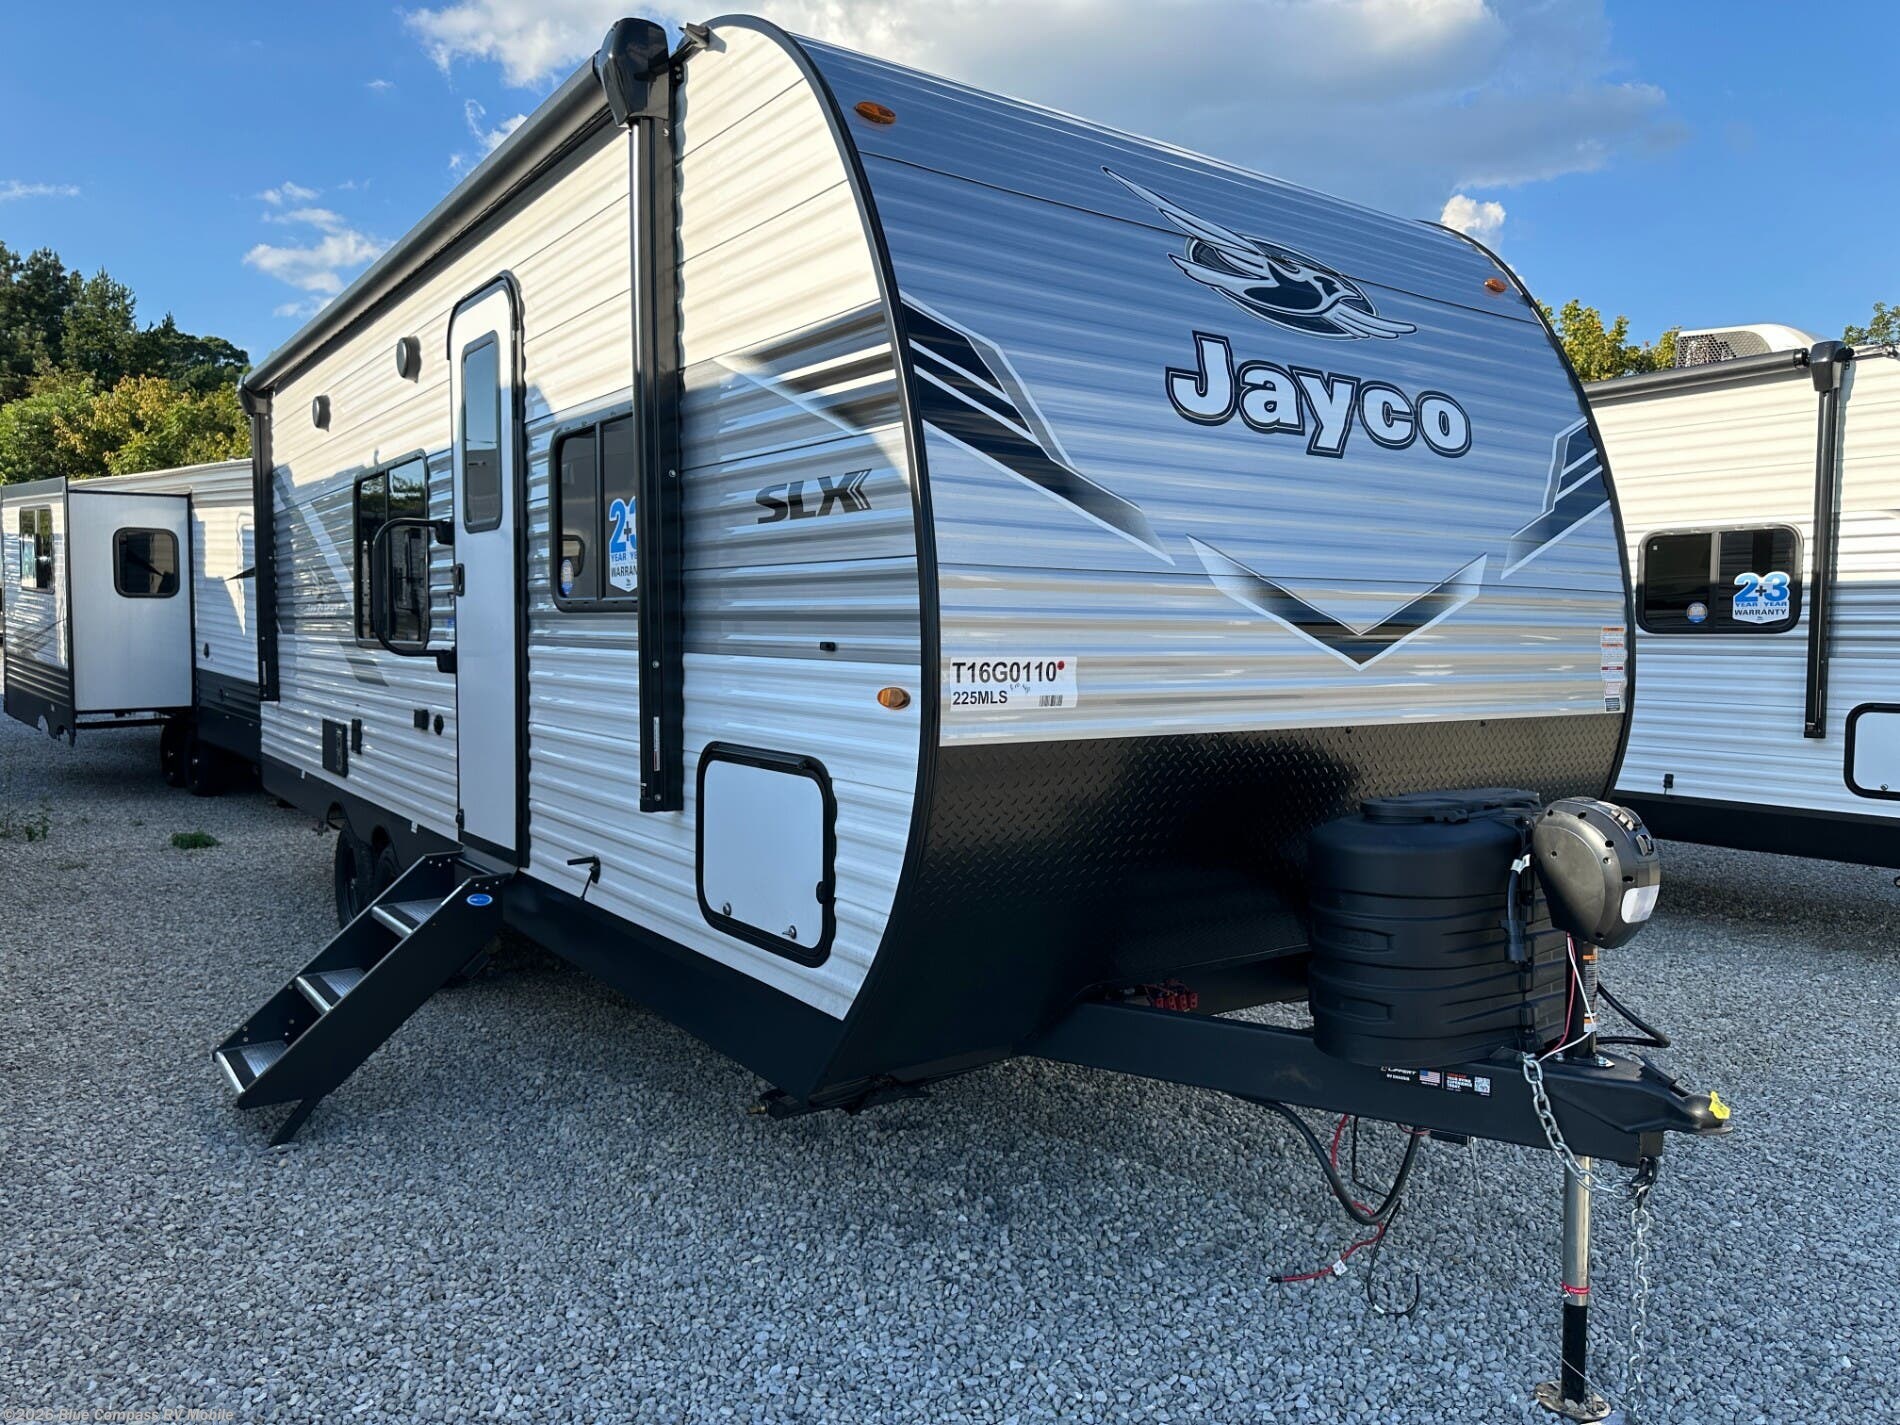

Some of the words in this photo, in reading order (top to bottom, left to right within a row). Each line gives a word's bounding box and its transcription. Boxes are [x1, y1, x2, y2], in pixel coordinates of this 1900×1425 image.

[1165, 330, 1473, 459] Jayco
[756, 468, 873, 524] SLX
[610, 553, 627, 562] YEAR
[1734, 608, 1787, 616] WARRANTY
[952, 661, 1057, 683] T16G0110
[953, 690, 1008, 705] 225MLS
